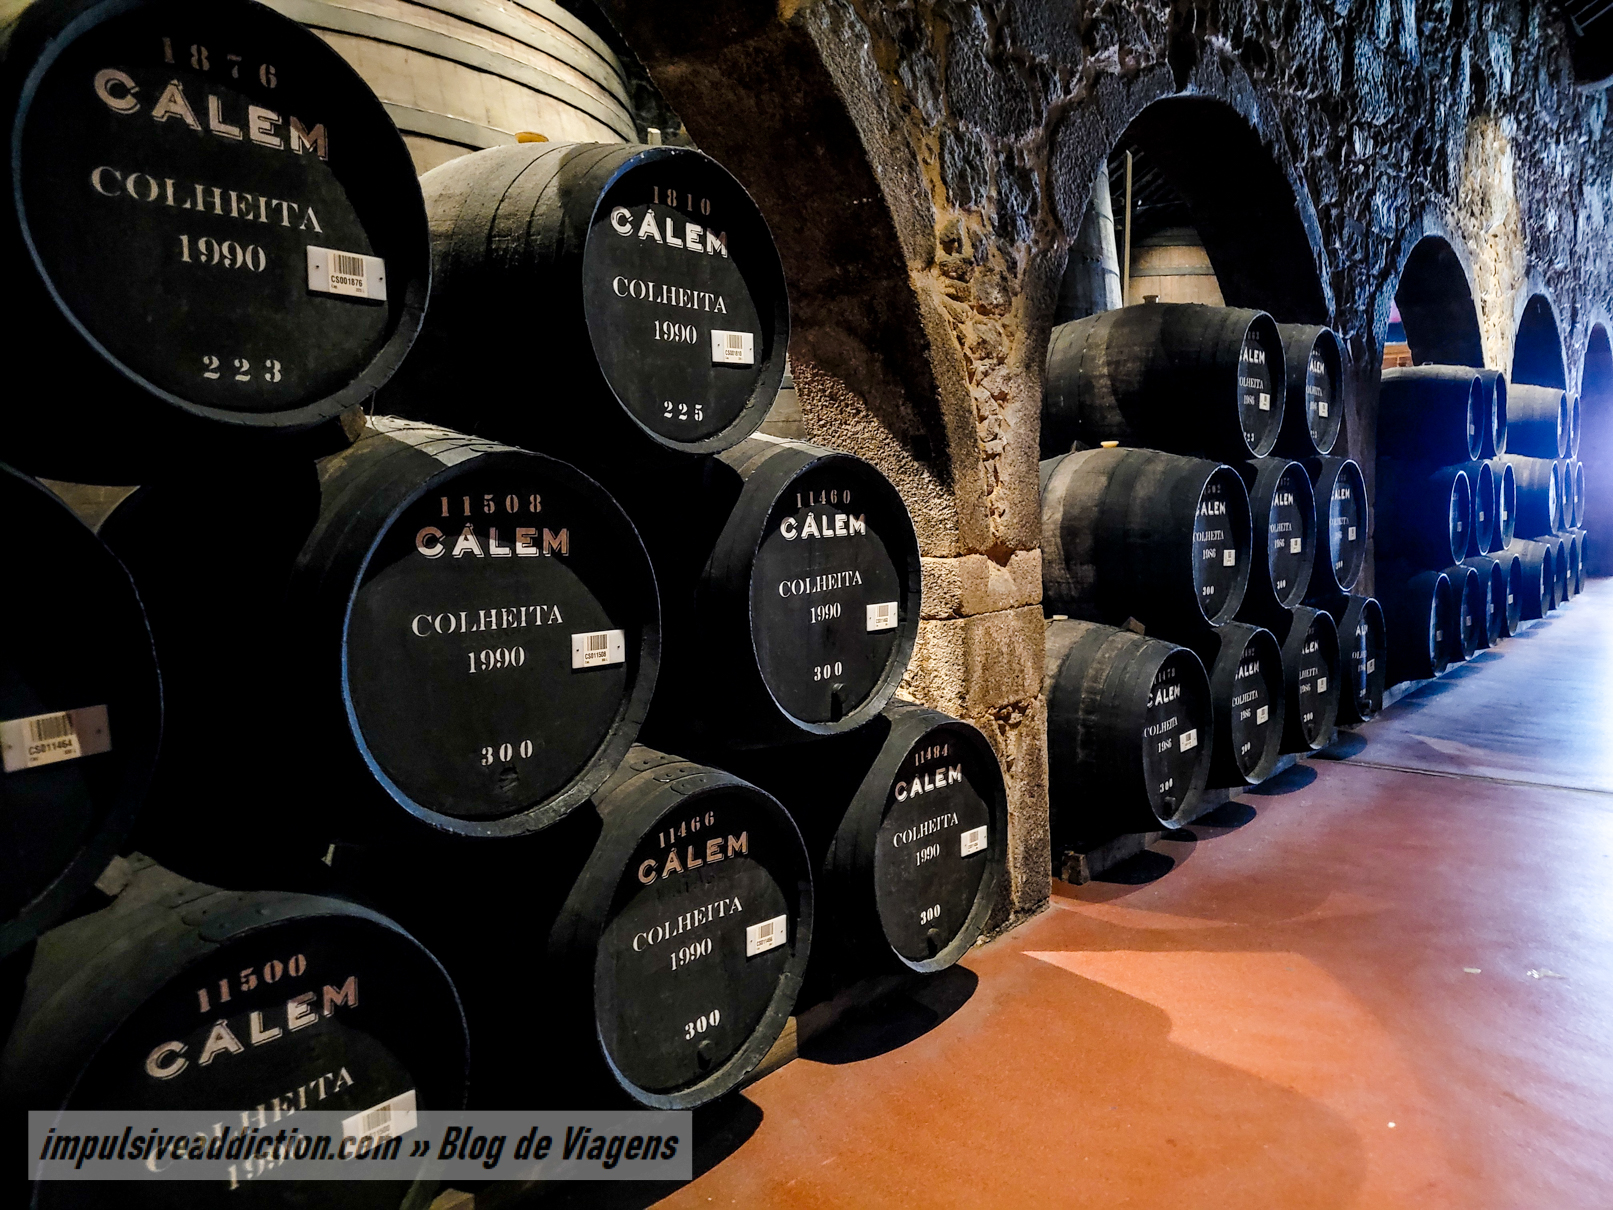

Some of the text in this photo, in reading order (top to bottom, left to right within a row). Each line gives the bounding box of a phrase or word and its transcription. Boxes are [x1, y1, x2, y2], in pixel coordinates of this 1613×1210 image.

[162, 37, 277, 89] 1876
[91, 166, 323, 233] COLHEITA
[653, 186, 711, 216] 1810
[179, 234, 267, 273] 1990
[330, 274, 363, 288] CS001876
[612, 275, 728, 315] COLHEITA
[653, 319, 698, 345] 1990
[203, 355, 282, 382] 223
[663, 400, 704, 422] 225
[441, 494, 541, 517] 11508
[797, 490, 851, 508] 11460
[778, 570, 863, 598] COLHEITA
[411, 605, 564, 637] COLHEITA
[810, 602, 842, 624] 1990
[468, 646, 526, 674] 1990
[814, 661, 843, 682] 300
[481, 740, 533, 766] 300
[915, 743, 949, 767] 11484
[659, 811, 715, 849] 11466
[892, 812, 960, 848] COLHEITA
[916, 843, 941, 867] 1990
[632, 896, 744, 952] COLHEITA
[920, 903, 942, 926] 300
[670, 937, 713, 971] 1990
[198, 954, 307, 1014] 11500
[684, 1009, 721, 1041] 300
